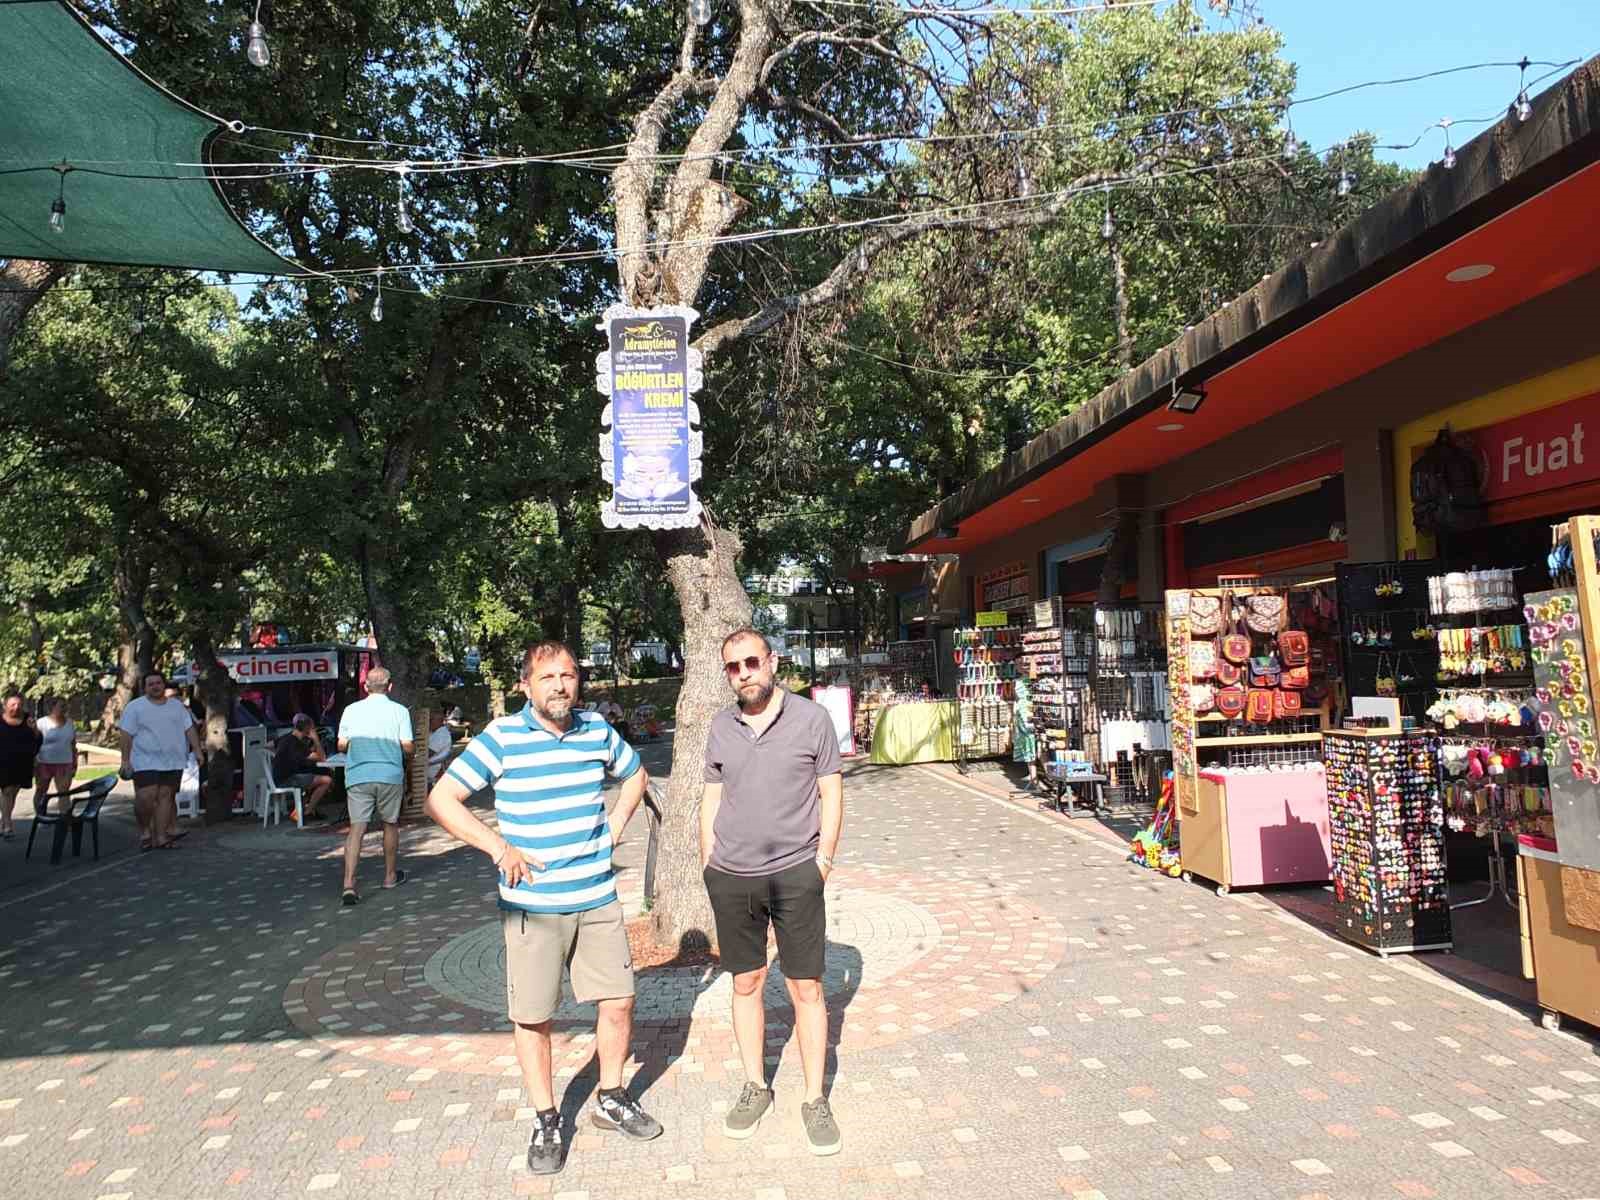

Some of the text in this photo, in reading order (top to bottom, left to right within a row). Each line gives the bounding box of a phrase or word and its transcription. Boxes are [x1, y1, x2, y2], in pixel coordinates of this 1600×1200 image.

[644, 390, 684, 409] KREMİ
[1503, 422, 1585, 483] Fuat
[236, 657, 329, 676] cinema
